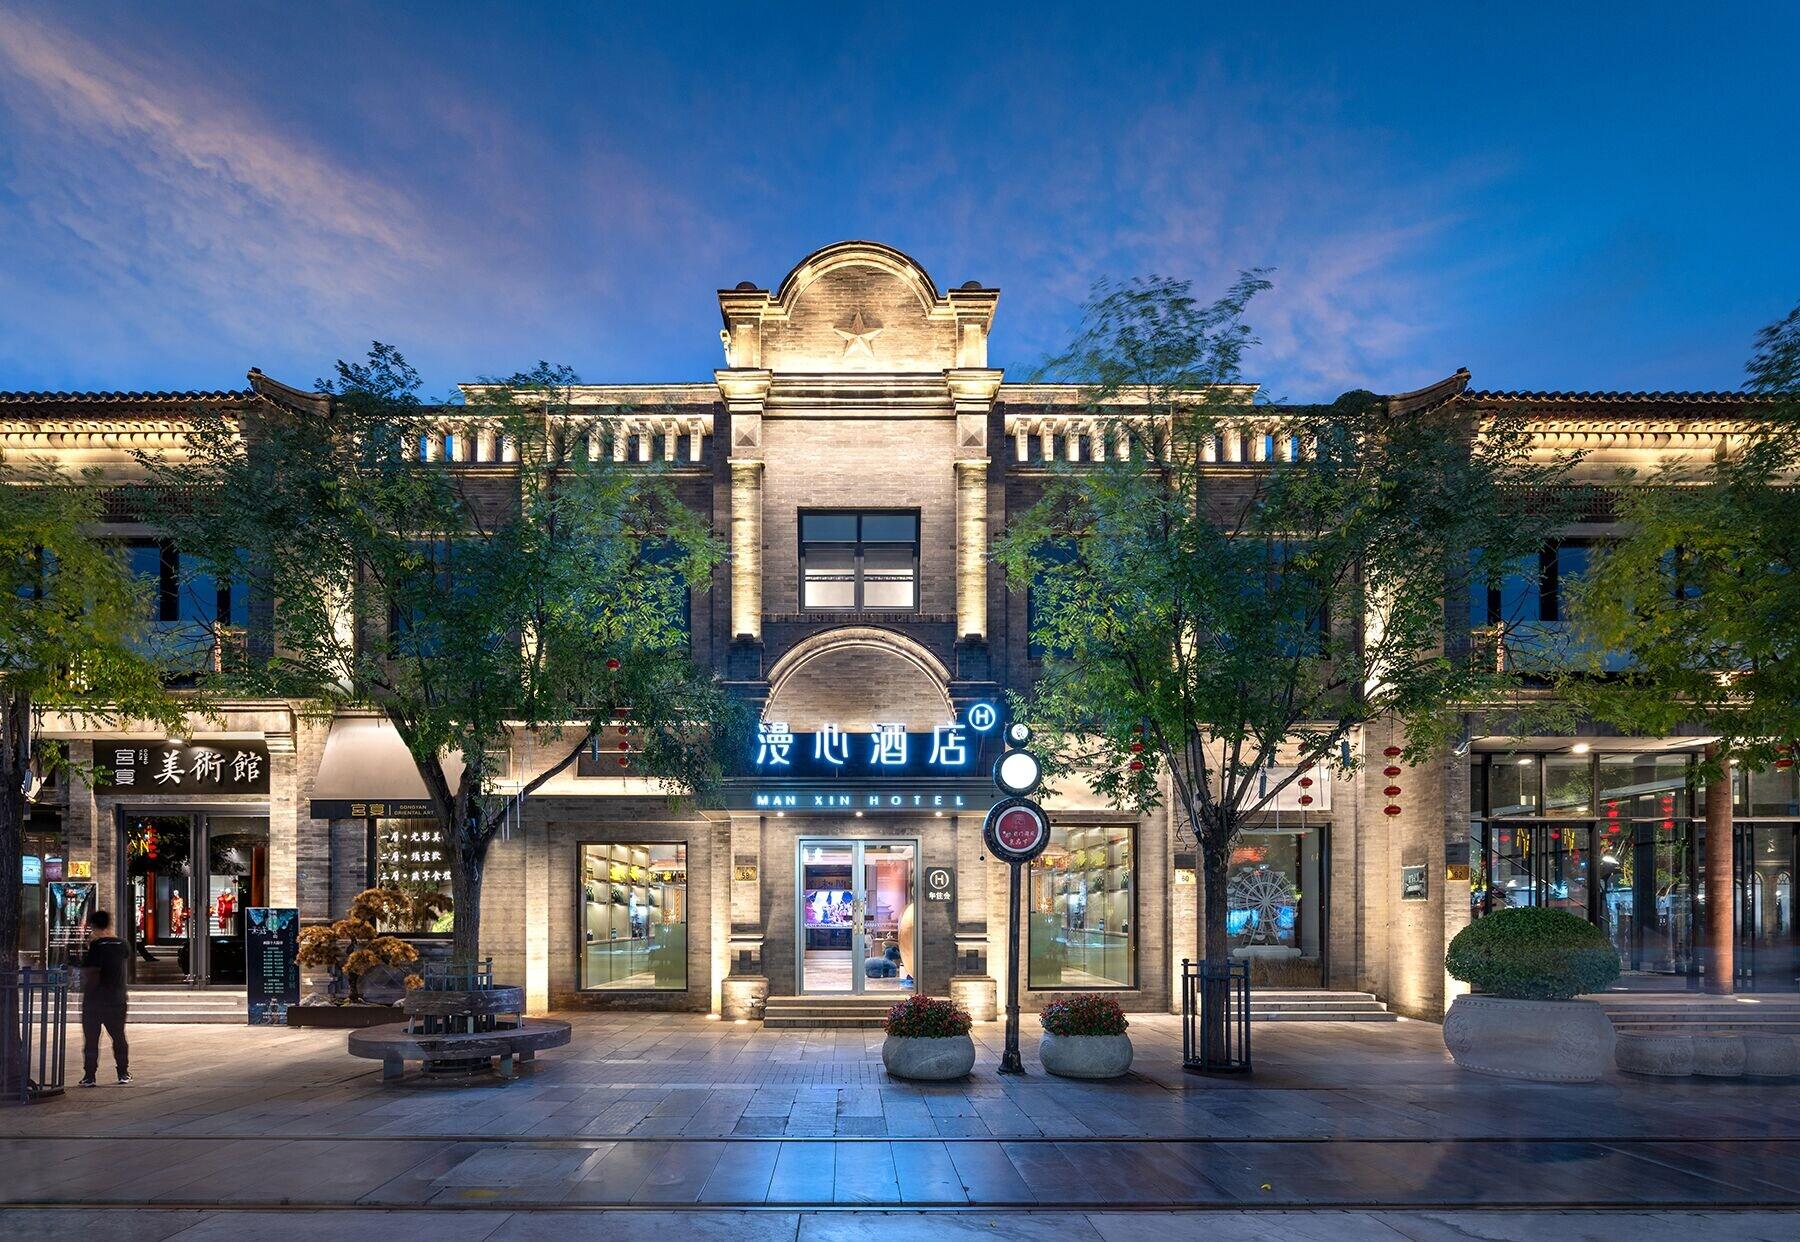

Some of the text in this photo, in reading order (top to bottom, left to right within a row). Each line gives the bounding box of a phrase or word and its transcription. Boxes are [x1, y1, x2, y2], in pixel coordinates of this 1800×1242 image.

[756, 721, 966, 765] 漫心酒店
[153, 749, 263, 785] 美術館
[756, 795, 964, 806] MAN XIN HOTEL
